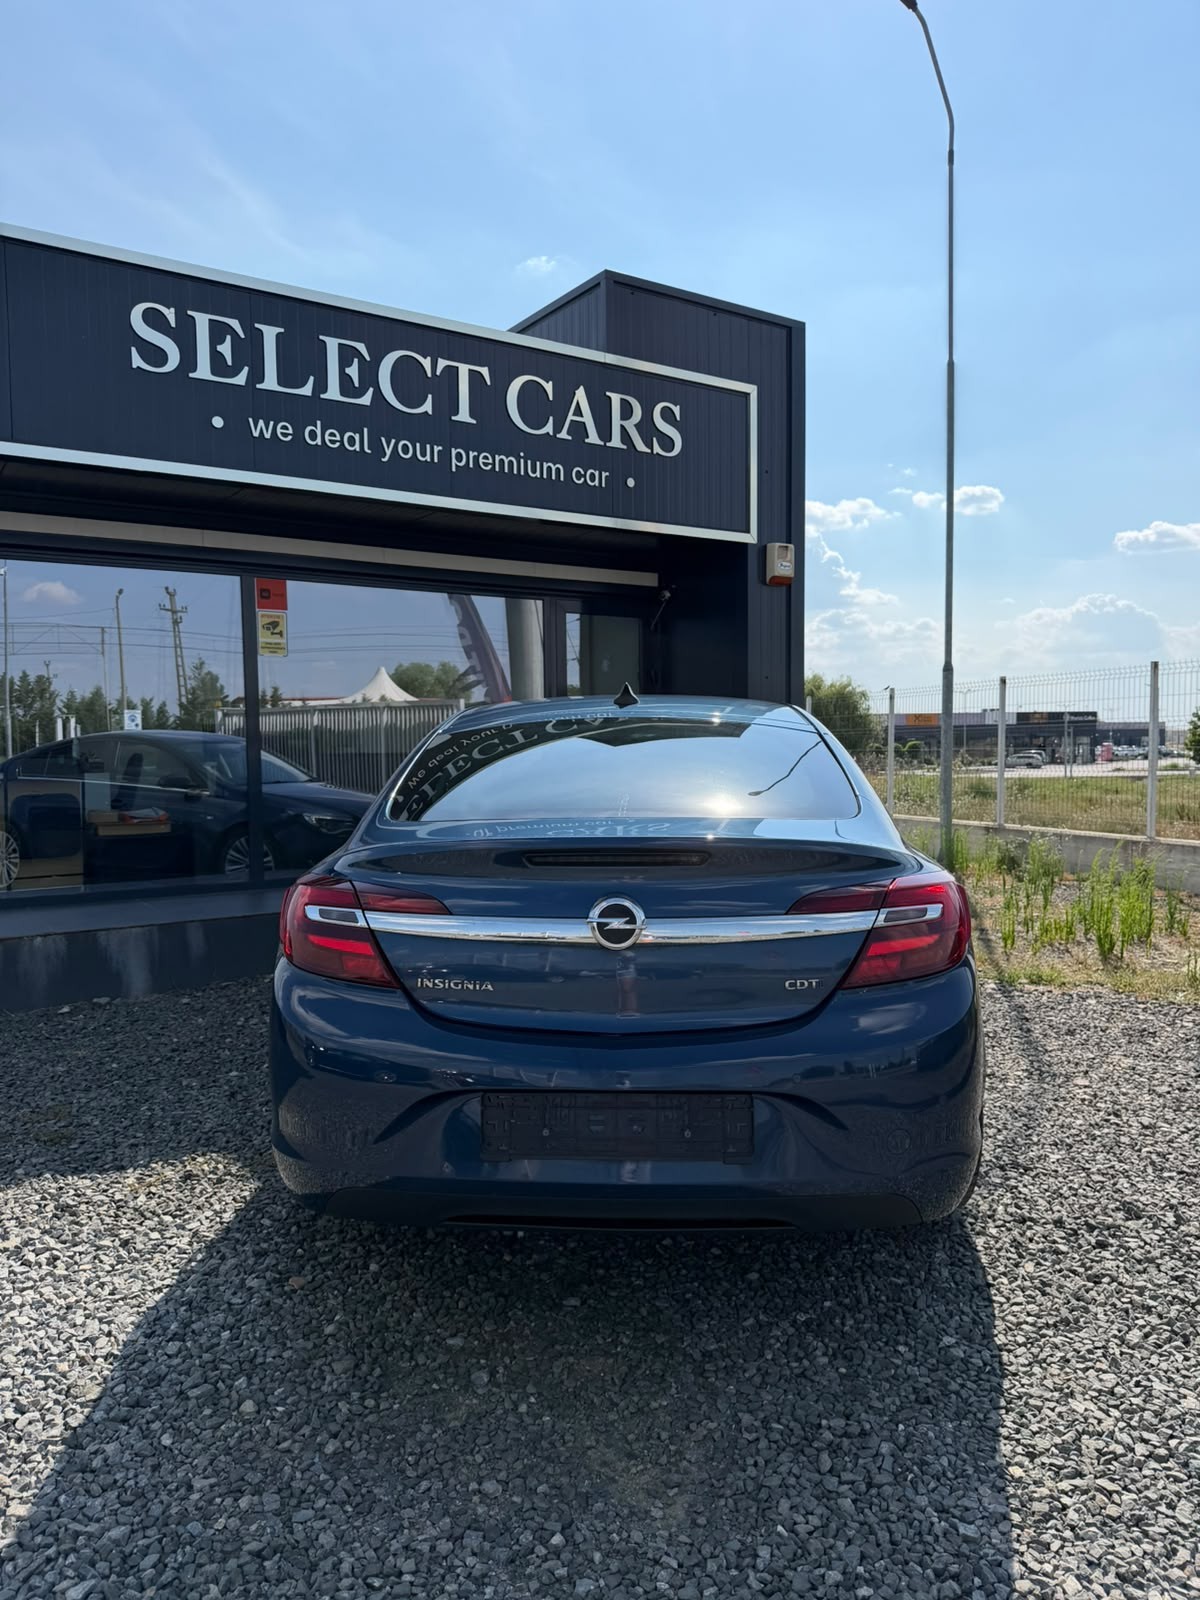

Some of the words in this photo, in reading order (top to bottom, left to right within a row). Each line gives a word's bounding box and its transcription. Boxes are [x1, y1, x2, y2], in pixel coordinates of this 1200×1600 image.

[129, 301, 492, 425] SELECT
[505, 374, 684, 458] CARS
[248, 416, 294, 442] we
[304, 420, 372, 454] deal
[380, 436, 443, 463] your
[450, 446, 565, 482] premium
[571, 466, 610, 488] car
[417, 977, 495, 991] INSIGNIA
[784, 978, 820, 990] CDT
